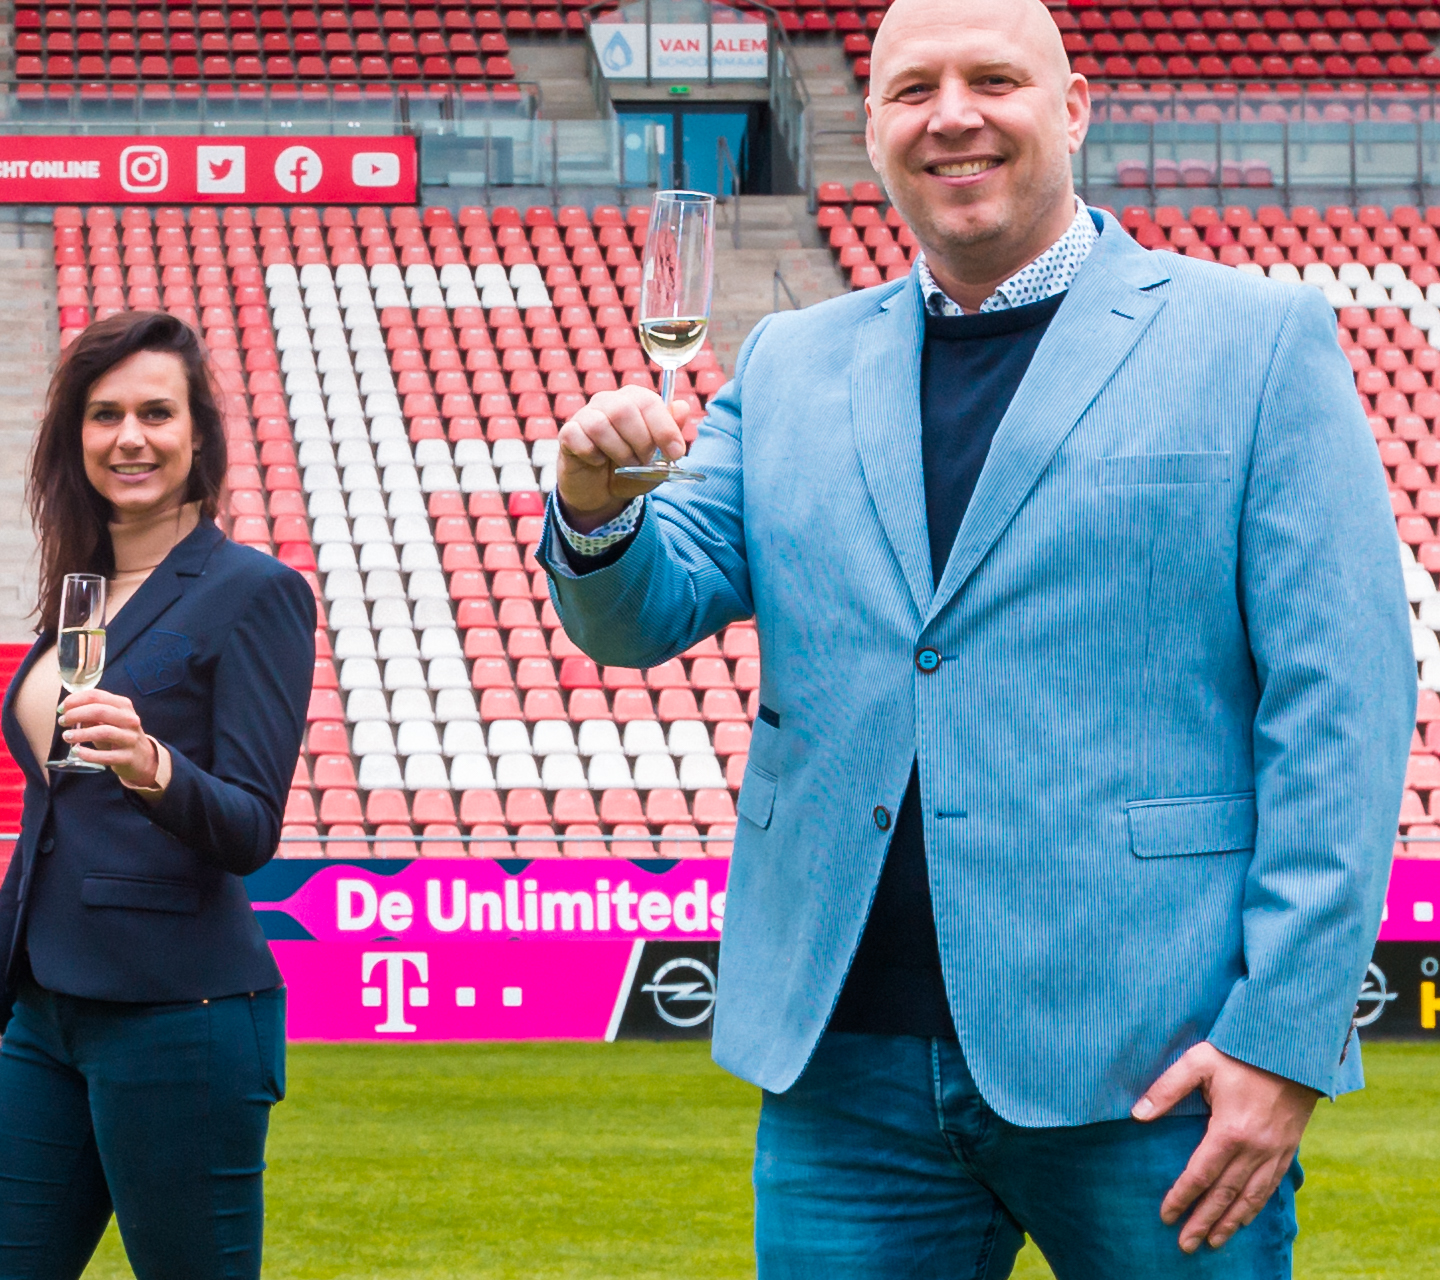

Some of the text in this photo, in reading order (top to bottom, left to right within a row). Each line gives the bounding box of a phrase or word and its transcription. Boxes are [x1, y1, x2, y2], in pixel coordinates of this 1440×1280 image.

[659, 39, 768, 52] VAN ALEM
[30, 160, 101, 179] ONLINE
[337, 879, 413, 932] De
[361, 951, 429, 1033] T
